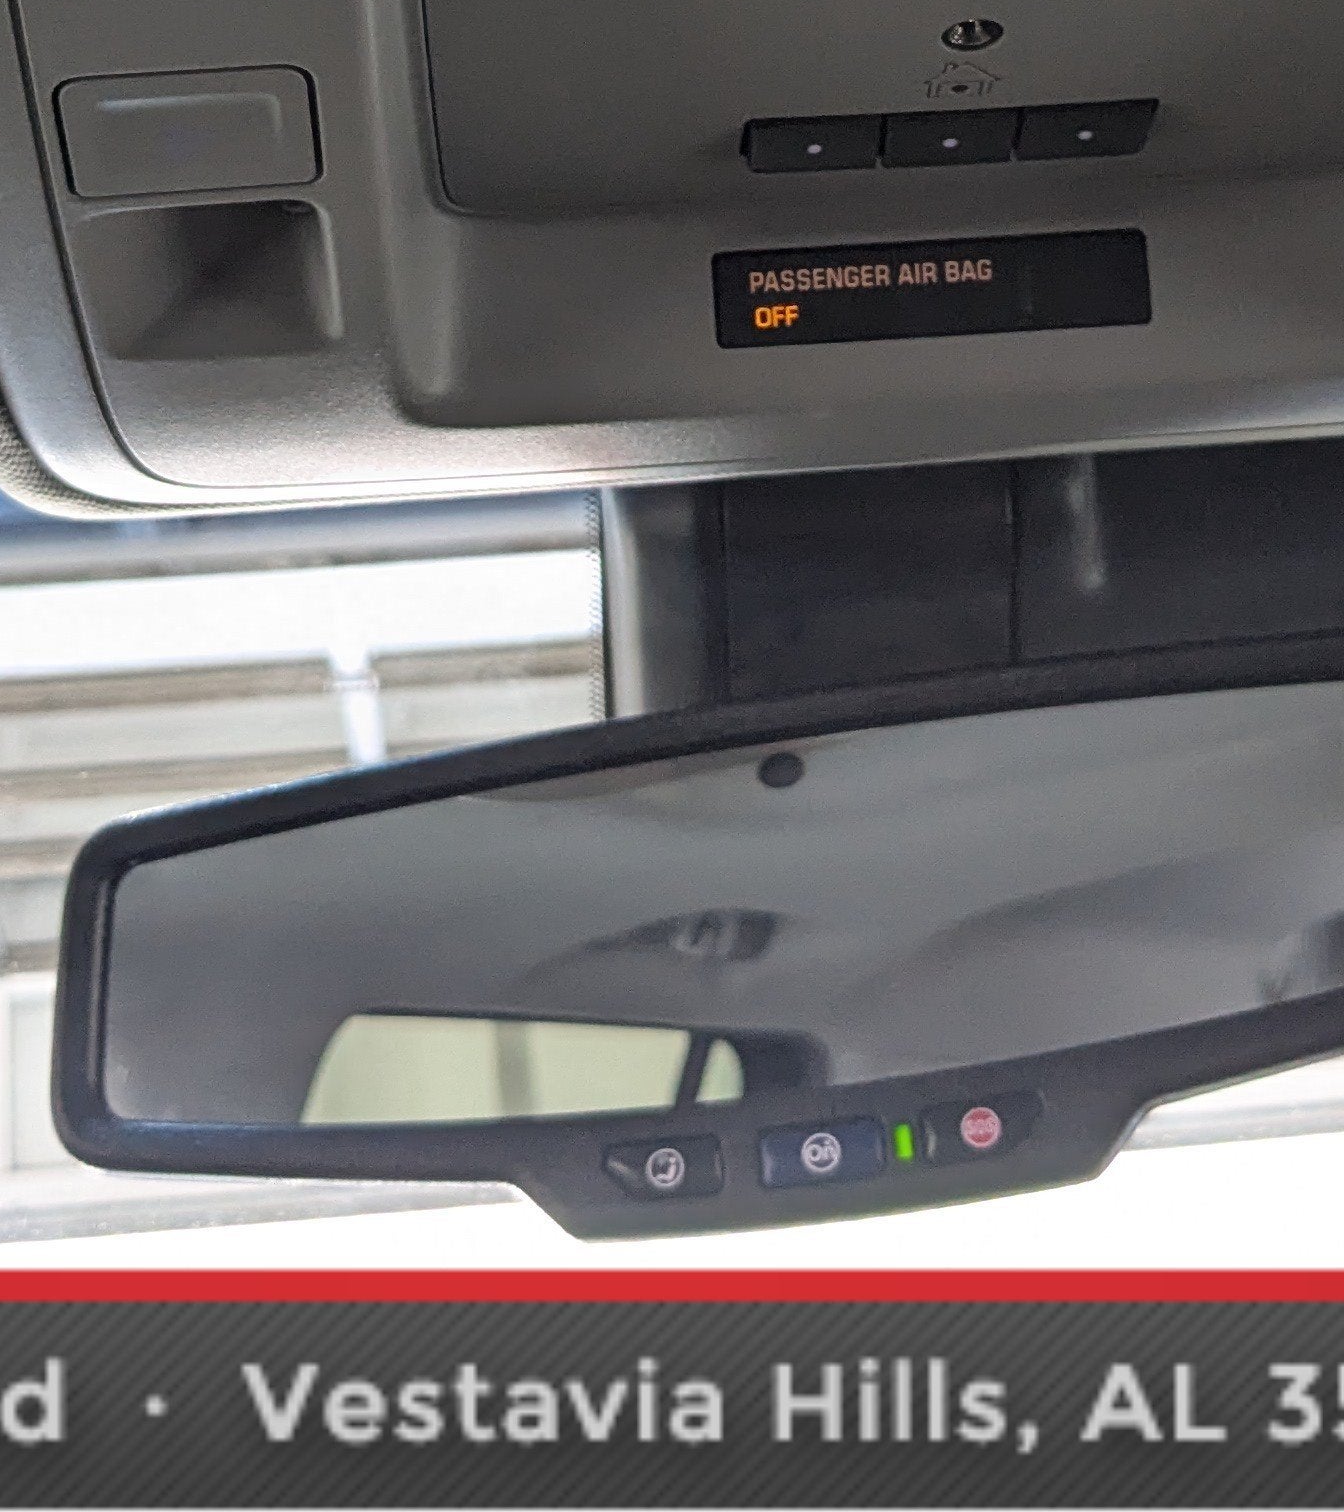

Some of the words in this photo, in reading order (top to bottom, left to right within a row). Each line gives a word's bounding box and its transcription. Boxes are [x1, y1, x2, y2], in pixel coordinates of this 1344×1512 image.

[749, 264, 891, 294] PASSENGER
[897, 261, 938, 285] AIR
[944, 258, 994, 283] BAG
[753, 304, 800, 330] OFF
